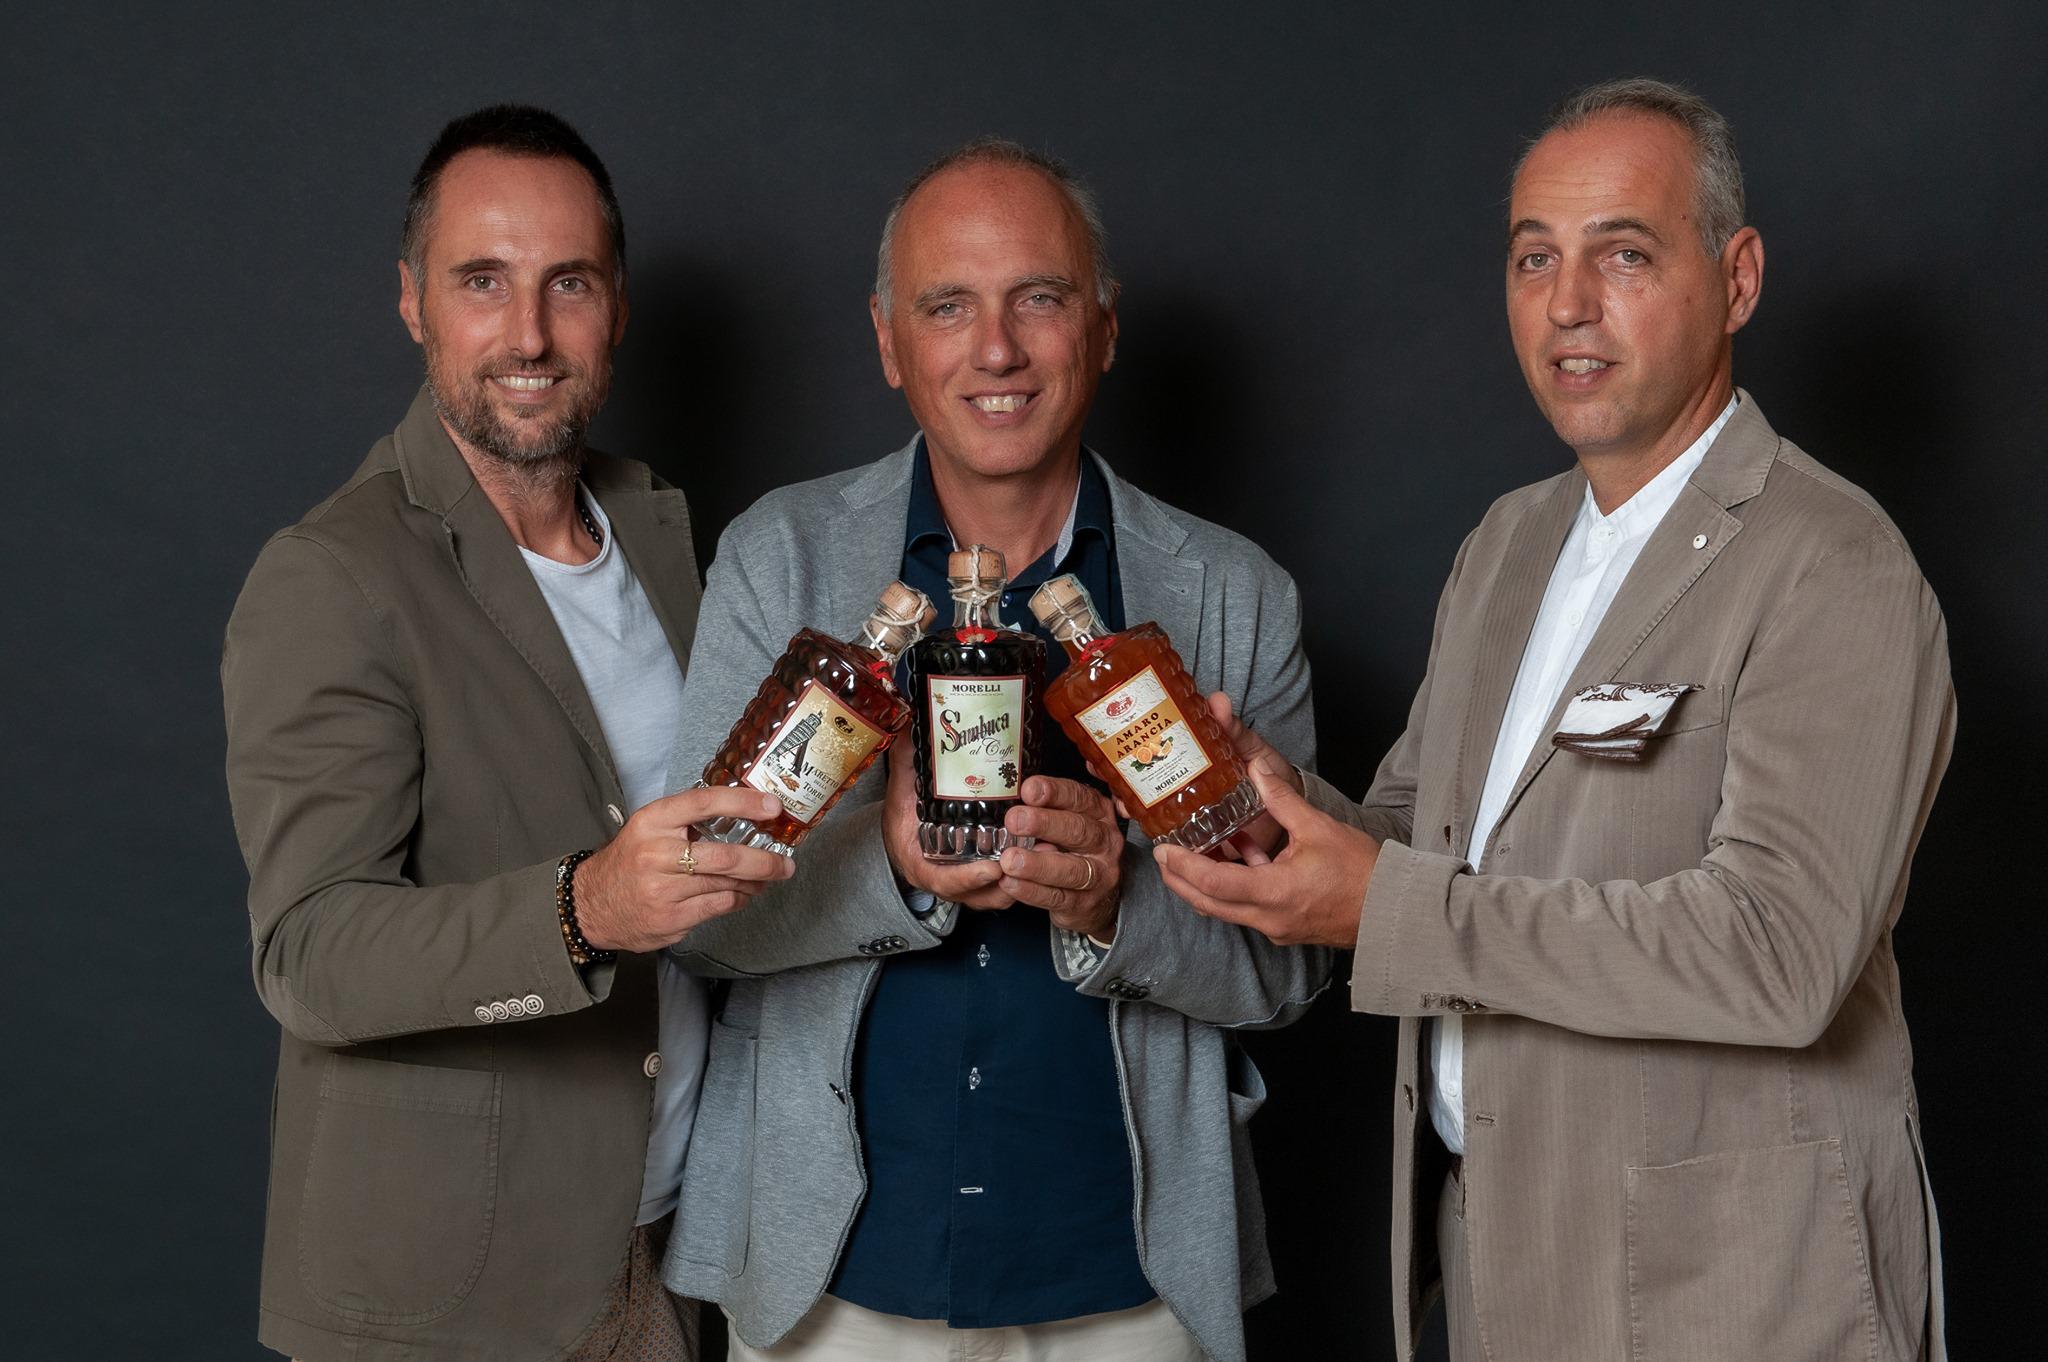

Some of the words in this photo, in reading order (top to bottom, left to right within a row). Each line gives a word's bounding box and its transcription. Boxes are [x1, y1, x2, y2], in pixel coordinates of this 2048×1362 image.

[952, 684, 1001, 693] MORELLI
[940, 709, 1009, 754] Sambuca
[1116, 712, 1159, 745] AMARO
[1117, 718, 1173, 758] ARANCIA
[969, 745, 982, 755] al
[1155, 767, 1189, 791] MORELLI
[772, 787, 798, 808] MORELLI
[803, 781, 825, 800] TORRE
